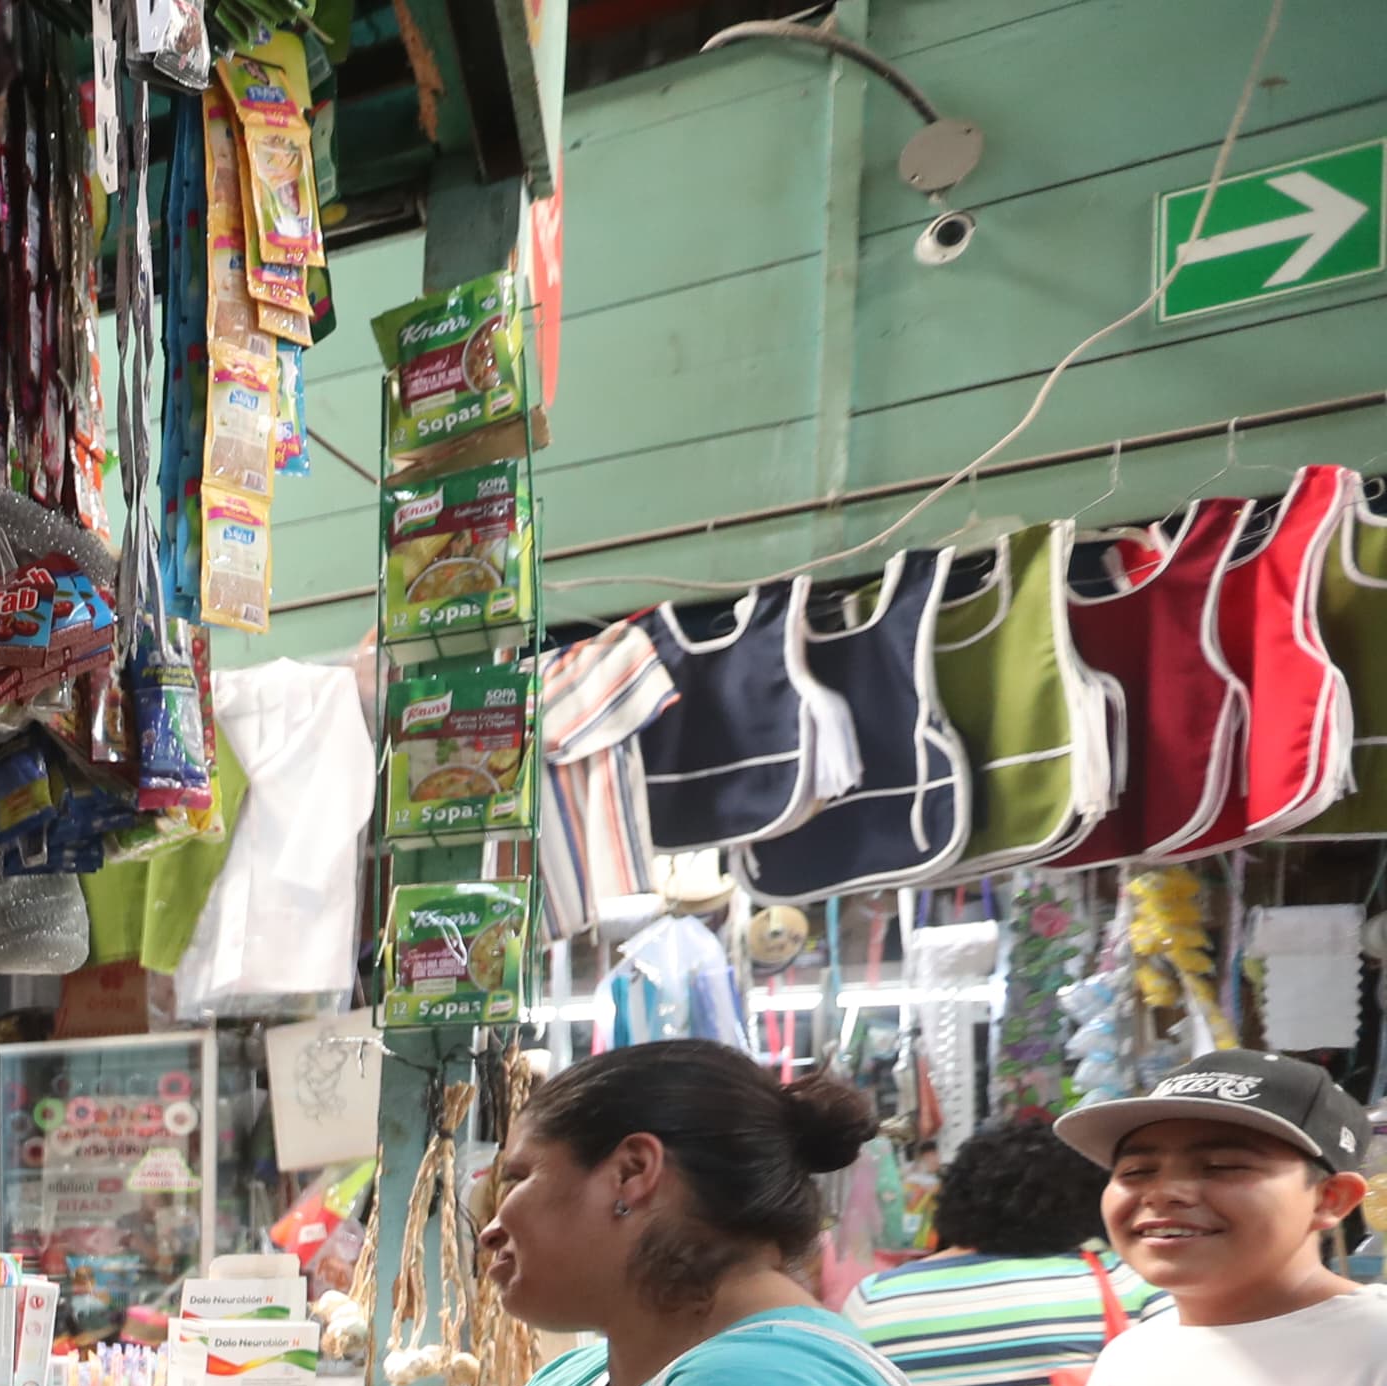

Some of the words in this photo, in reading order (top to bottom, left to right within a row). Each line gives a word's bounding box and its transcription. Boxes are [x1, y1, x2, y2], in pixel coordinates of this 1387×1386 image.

[401, 315, 471, 347] Knorr
[417, 403, 481, 437] Sopas
[397, 500, 441, 524] Knorr
[419, 603, 482, 626] Sopas
[405, 701, 448, 722] Knorr
[394, 809, 410, 823] 12
[418, 999, 481, 1017] Sopas
[189, 1295, 212, 1305] Dolo
[213, 1295, 263, 1305] Neurobión
[214, 1338, 238, 1348] Dolo
[239, 1337, 290, 1348] Neurobión
